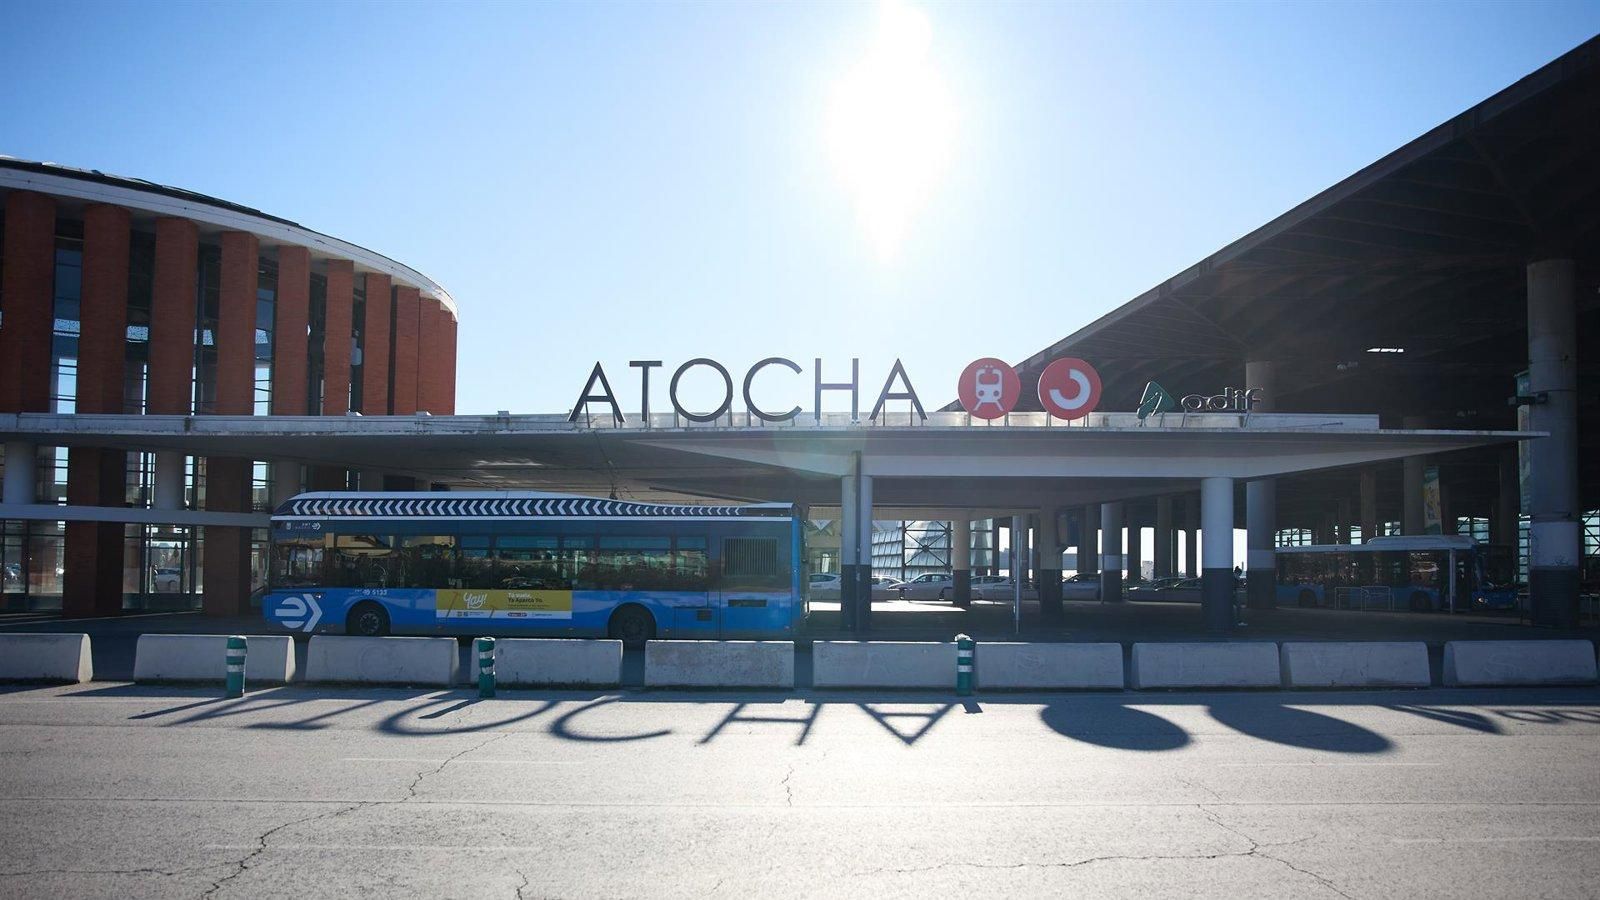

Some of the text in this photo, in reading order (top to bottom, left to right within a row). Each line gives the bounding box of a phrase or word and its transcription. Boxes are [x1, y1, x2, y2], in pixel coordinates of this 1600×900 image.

[568, 357, 929, 423] ATOCHA
[1180, 386, 1264, 411] adif
[463, 591, 488, 609] Yay!
